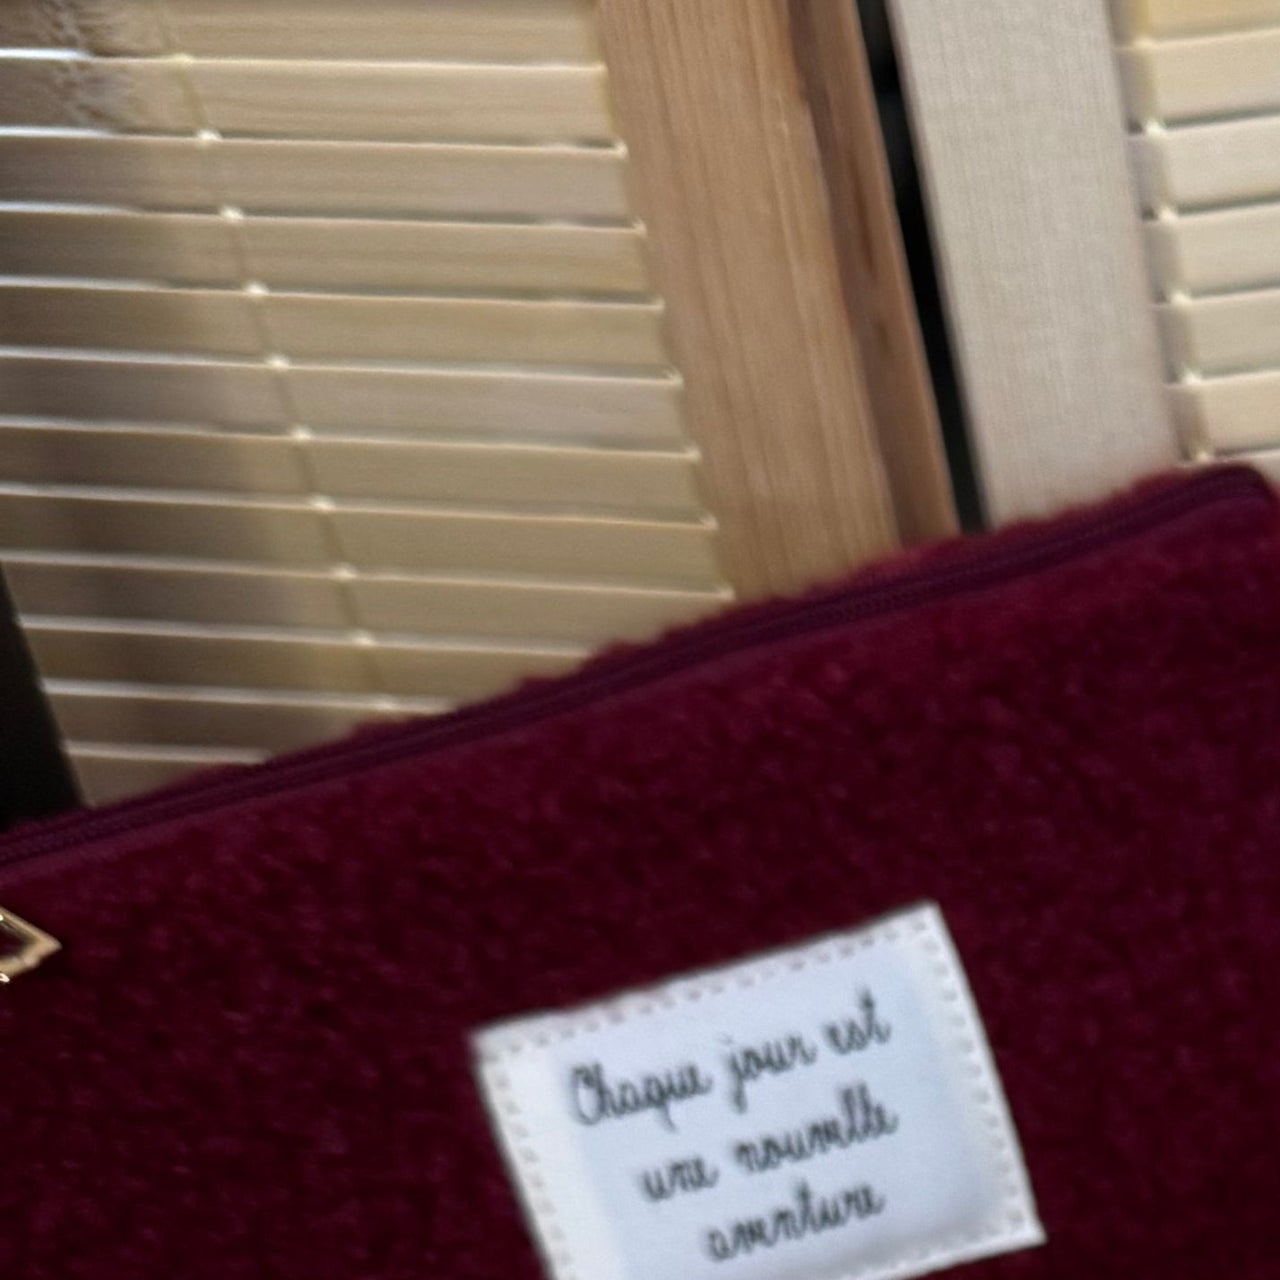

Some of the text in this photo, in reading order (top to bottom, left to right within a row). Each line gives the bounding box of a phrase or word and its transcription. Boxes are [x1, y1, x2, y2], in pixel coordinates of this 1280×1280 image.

[568, 986, 892, 1132] Chaque jour est
[638, 1154, 720, 1202] une
